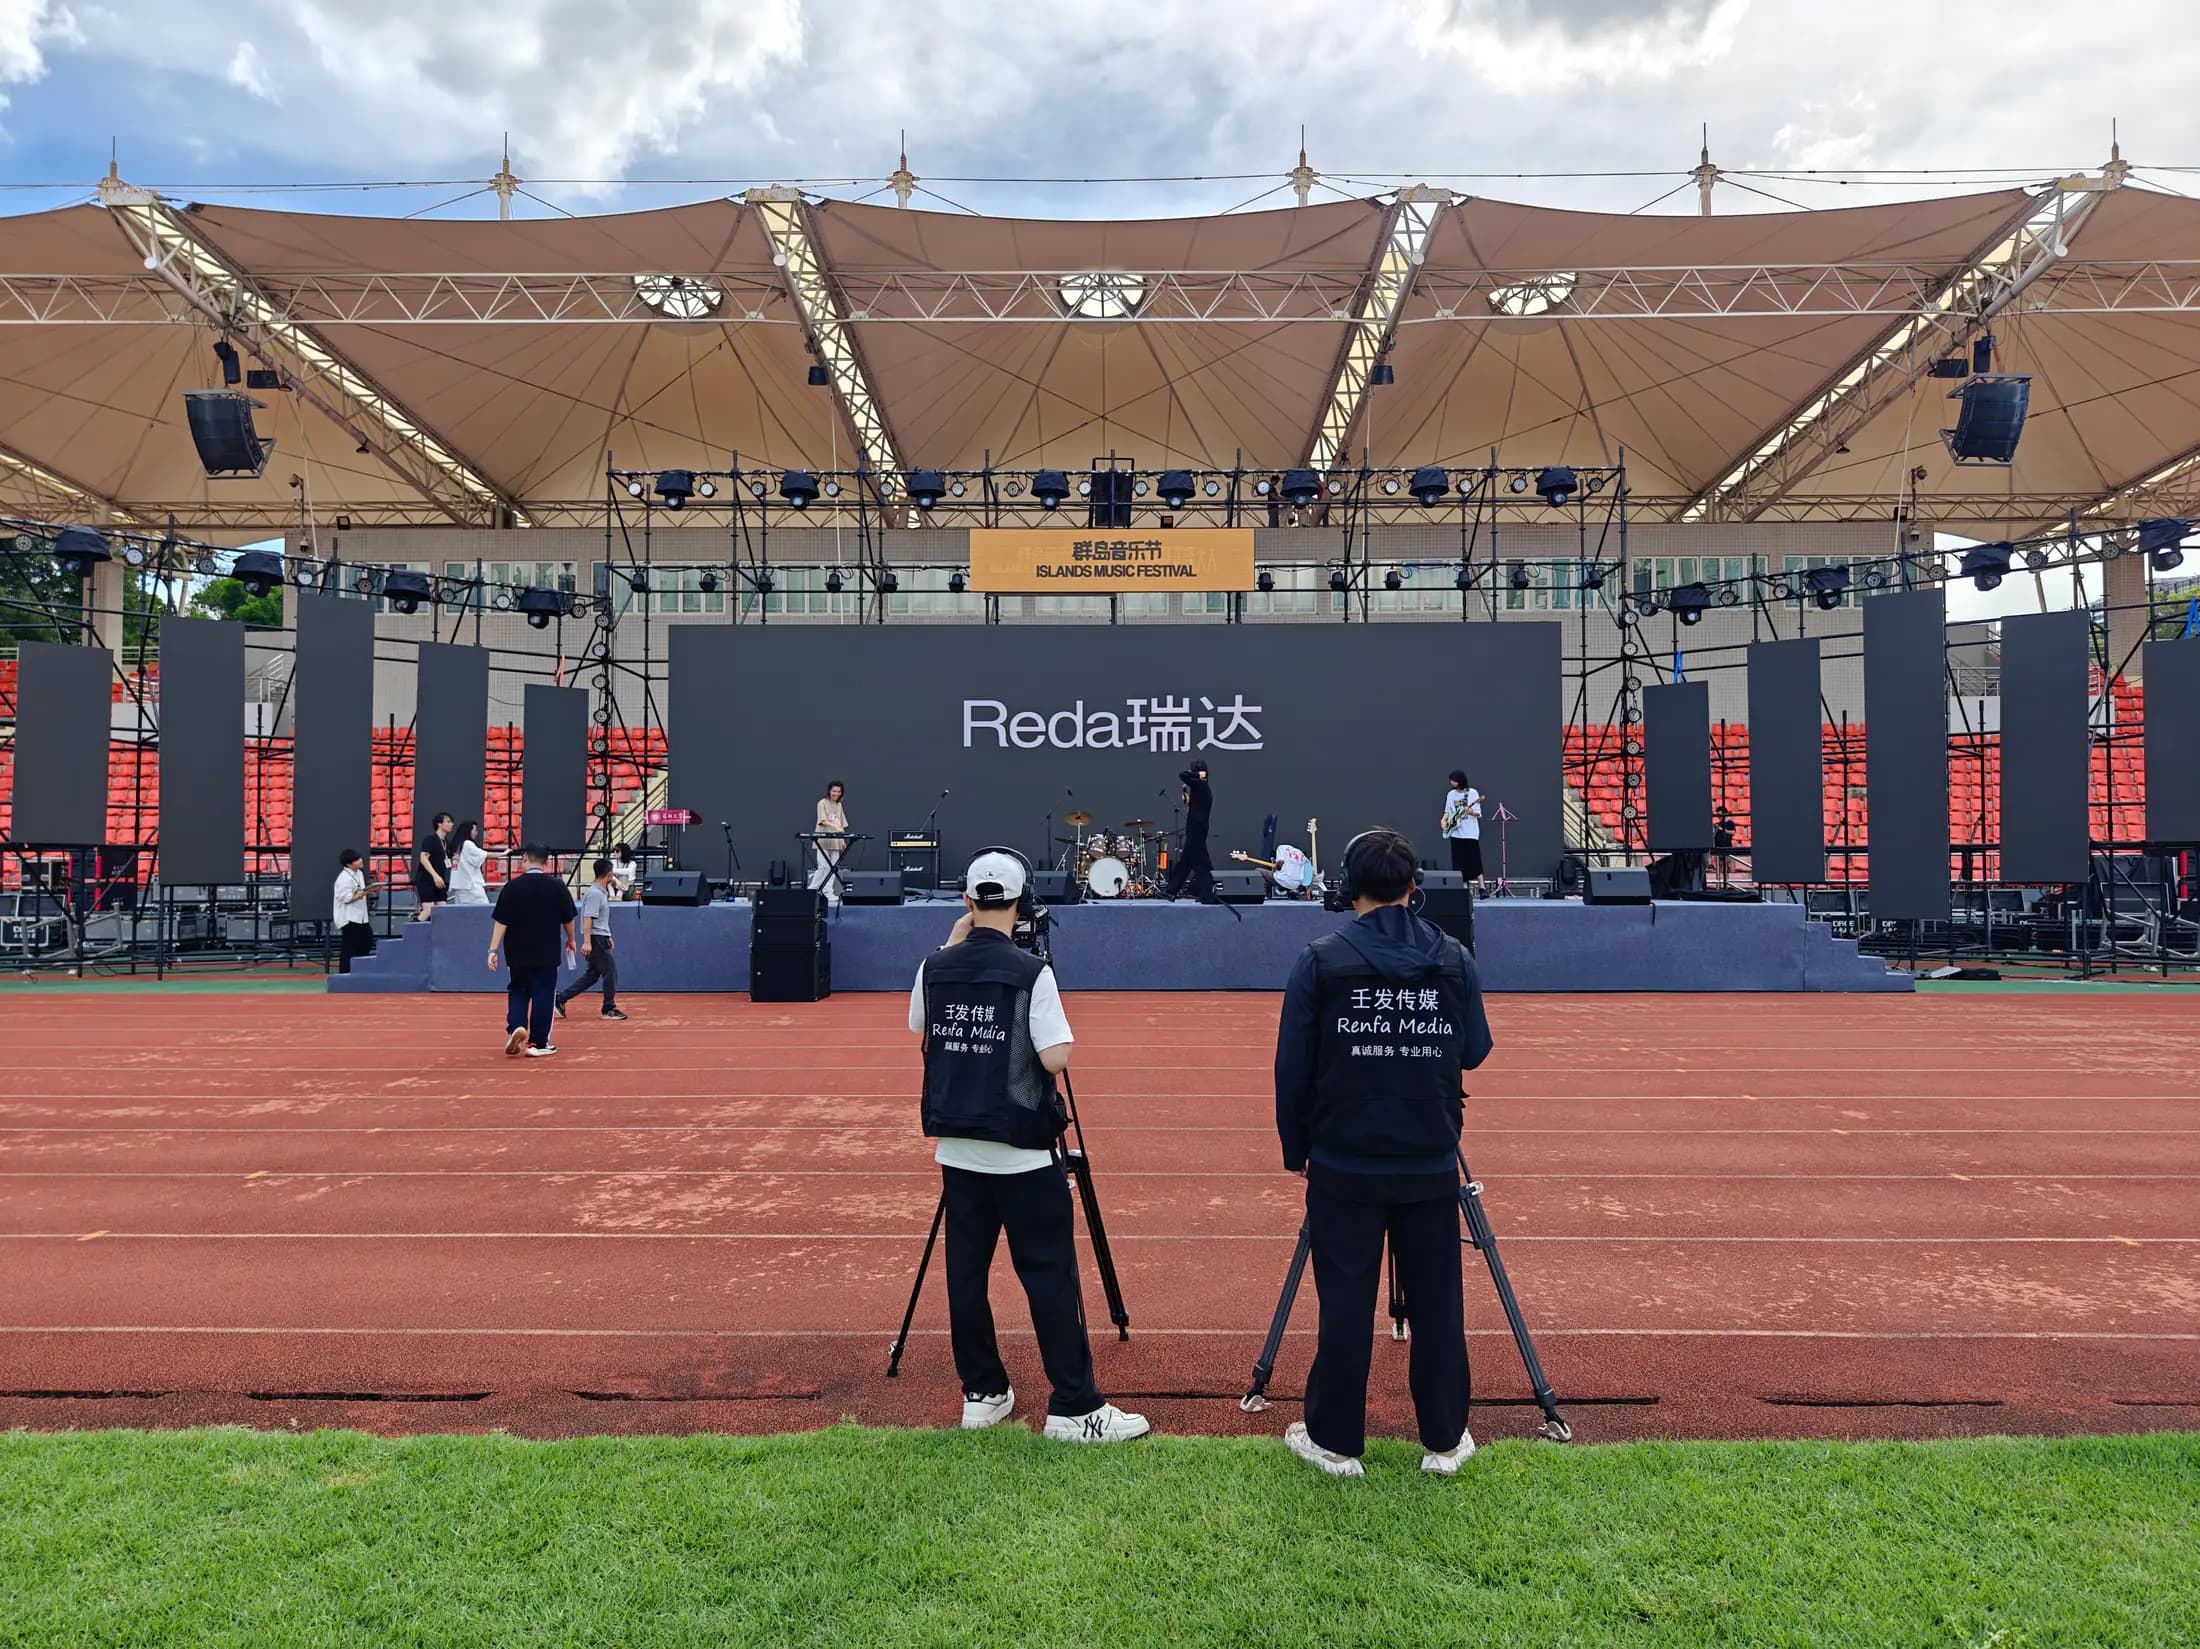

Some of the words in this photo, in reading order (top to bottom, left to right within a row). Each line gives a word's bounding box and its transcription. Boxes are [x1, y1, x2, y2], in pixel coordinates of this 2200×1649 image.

[1072, 540, 1162, 561] 群岛音乐节
[1036, 565, 1092, 578] ISLANDS
[1094, 565, 1135, 578] MUSIC
[1137, 565, 1197, 578] FESTIVAL
[1337, 1015, 1391, 1034] Renfa
[1399, 1017, 1453, 1035] Media
[1351, 1045, 1395, 1057] 真诚服务
[1400, 1046, 1443, 1057] 专业用心
